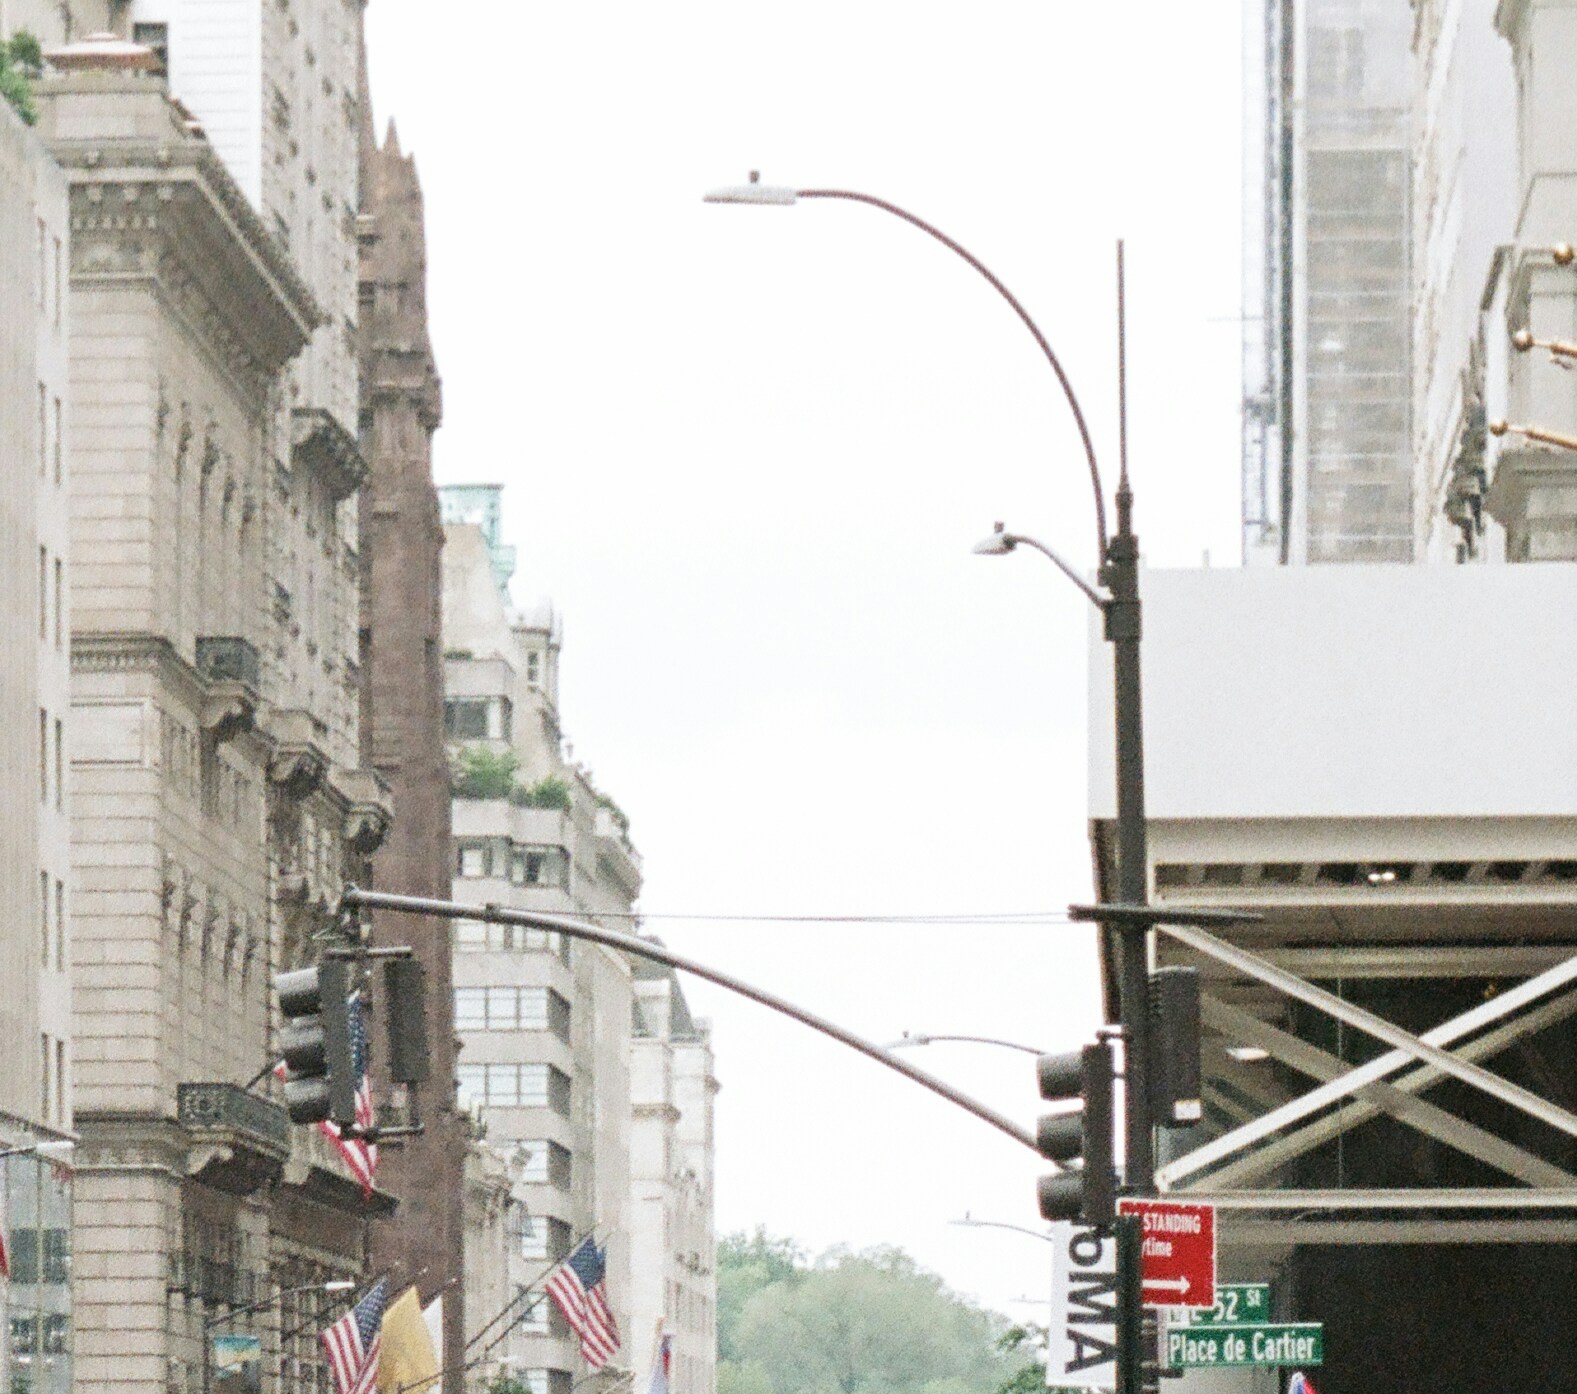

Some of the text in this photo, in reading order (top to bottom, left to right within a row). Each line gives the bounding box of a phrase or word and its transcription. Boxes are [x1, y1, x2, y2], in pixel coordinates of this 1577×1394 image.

[1143, 1213, 1200, 1234] STANDING
[1065, 1228, 1116, 1374] oMA
[1213, 1291, 1238, 1321] 52
[1170, 1331, 1315, 1362] Place de Cartier
